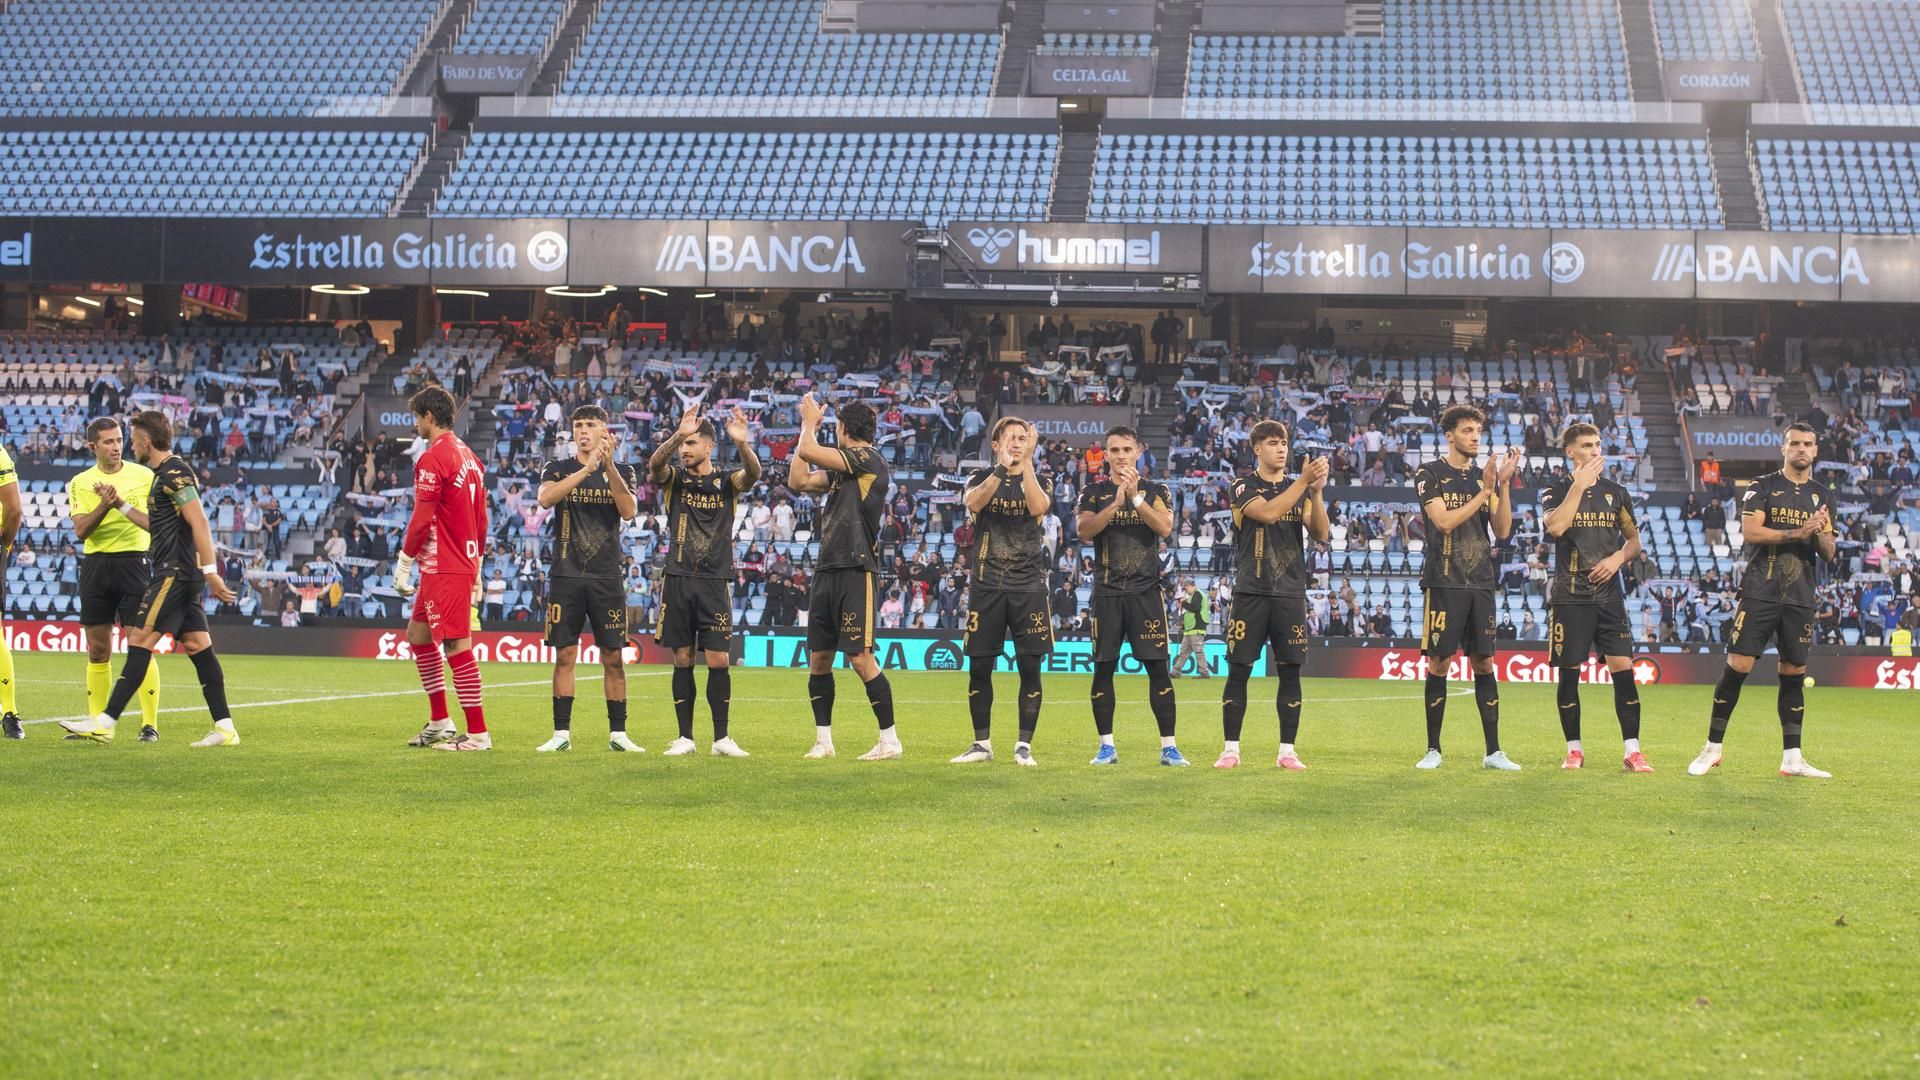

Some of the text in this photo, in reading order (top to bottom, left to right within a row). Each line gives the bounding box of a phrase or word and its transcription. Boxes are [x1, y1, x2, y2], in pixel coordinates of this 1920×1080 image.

[478, 67, 495, 79] DE
[1052, 68, 1131, 82] CELTA.GAL
[1679, 72, 1750, 88] CORAZÓN
[249, 232, 518, 270] Estrella Galicia
[1017, 230, 1160, 265] hummel
[1247, 241, 1532, 281] Estrella Galicia
[1028, 420, 1106, 435] ELTA.GAL
[1694, 429, 1784, 447] TRADICIÓN
[1575, 511, 1616, 521] AHRAIN
[1227, 618, 1246, 640] 28
[1430, 610, 1446, 632] 14
[1734, 610, 1746, 631] 4
[1554, 622, 1565, 643] 9
[932, 648, 957, 662] EA
[930, 661, 958, 669] SPORTS
